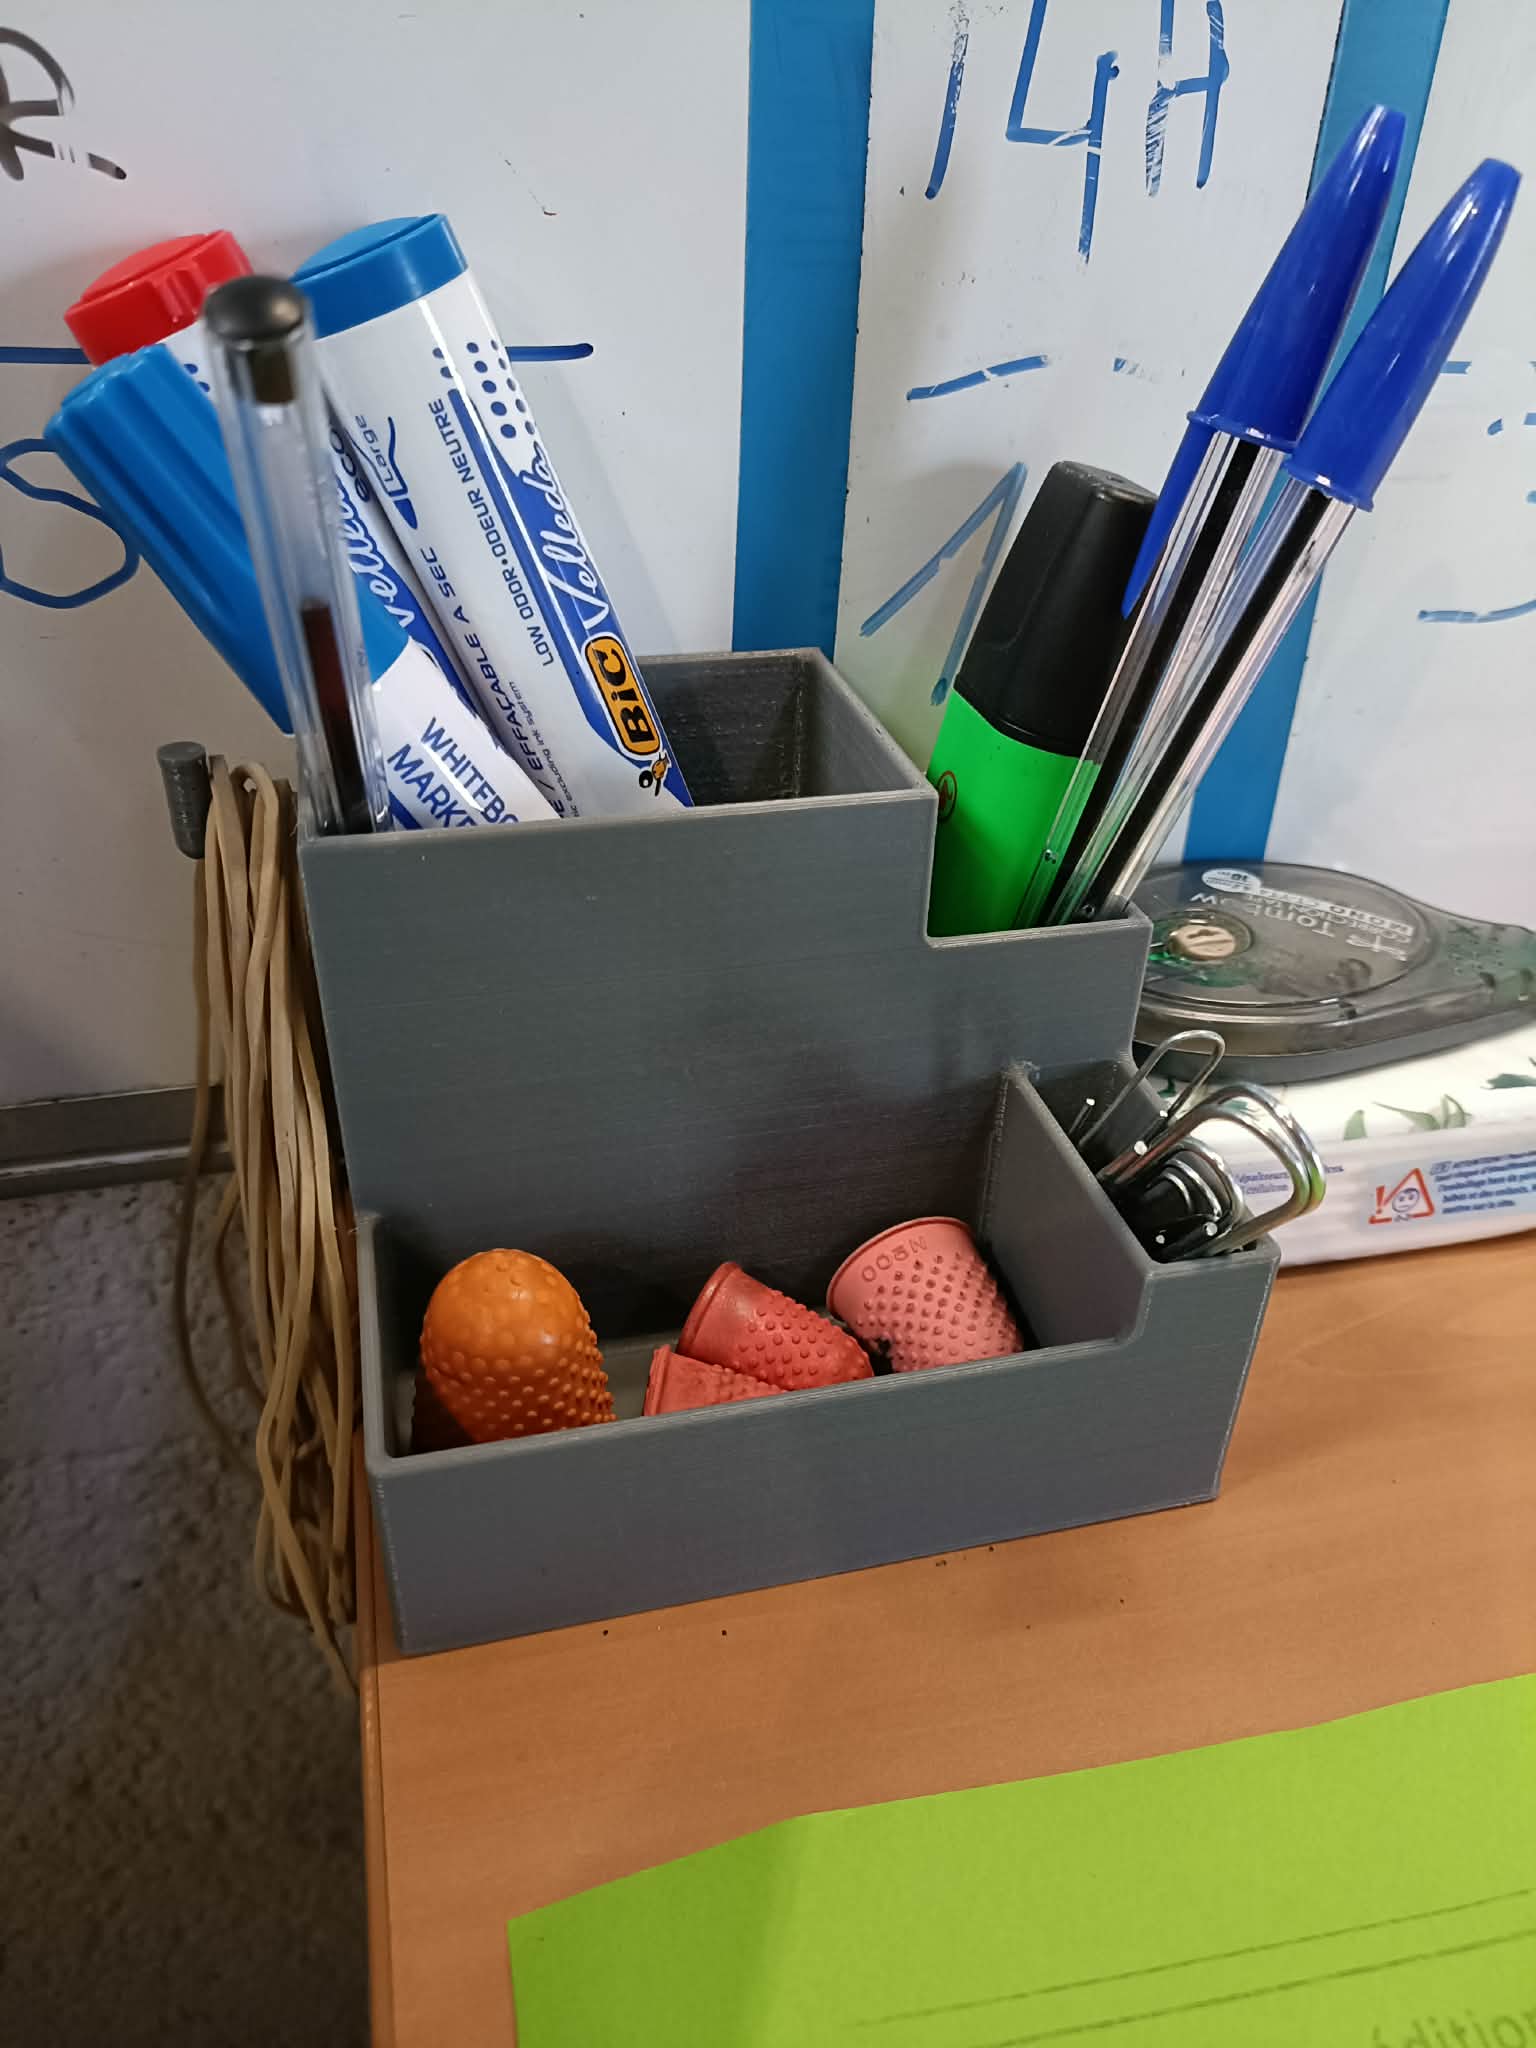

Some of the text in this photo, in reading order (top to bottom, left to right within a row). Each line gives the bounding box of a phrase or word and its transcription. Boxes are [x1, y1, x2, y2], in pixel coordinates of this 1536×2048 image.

[330, 427, 369, 502] eco
[355, 415, 394, 482] Large
[428, 398, 475, 484] NEUTRE
[521, 440, 611, 630] Velleda
[420, 547, 456, 598] SEC
[526, 625, 555, 667] LOW
